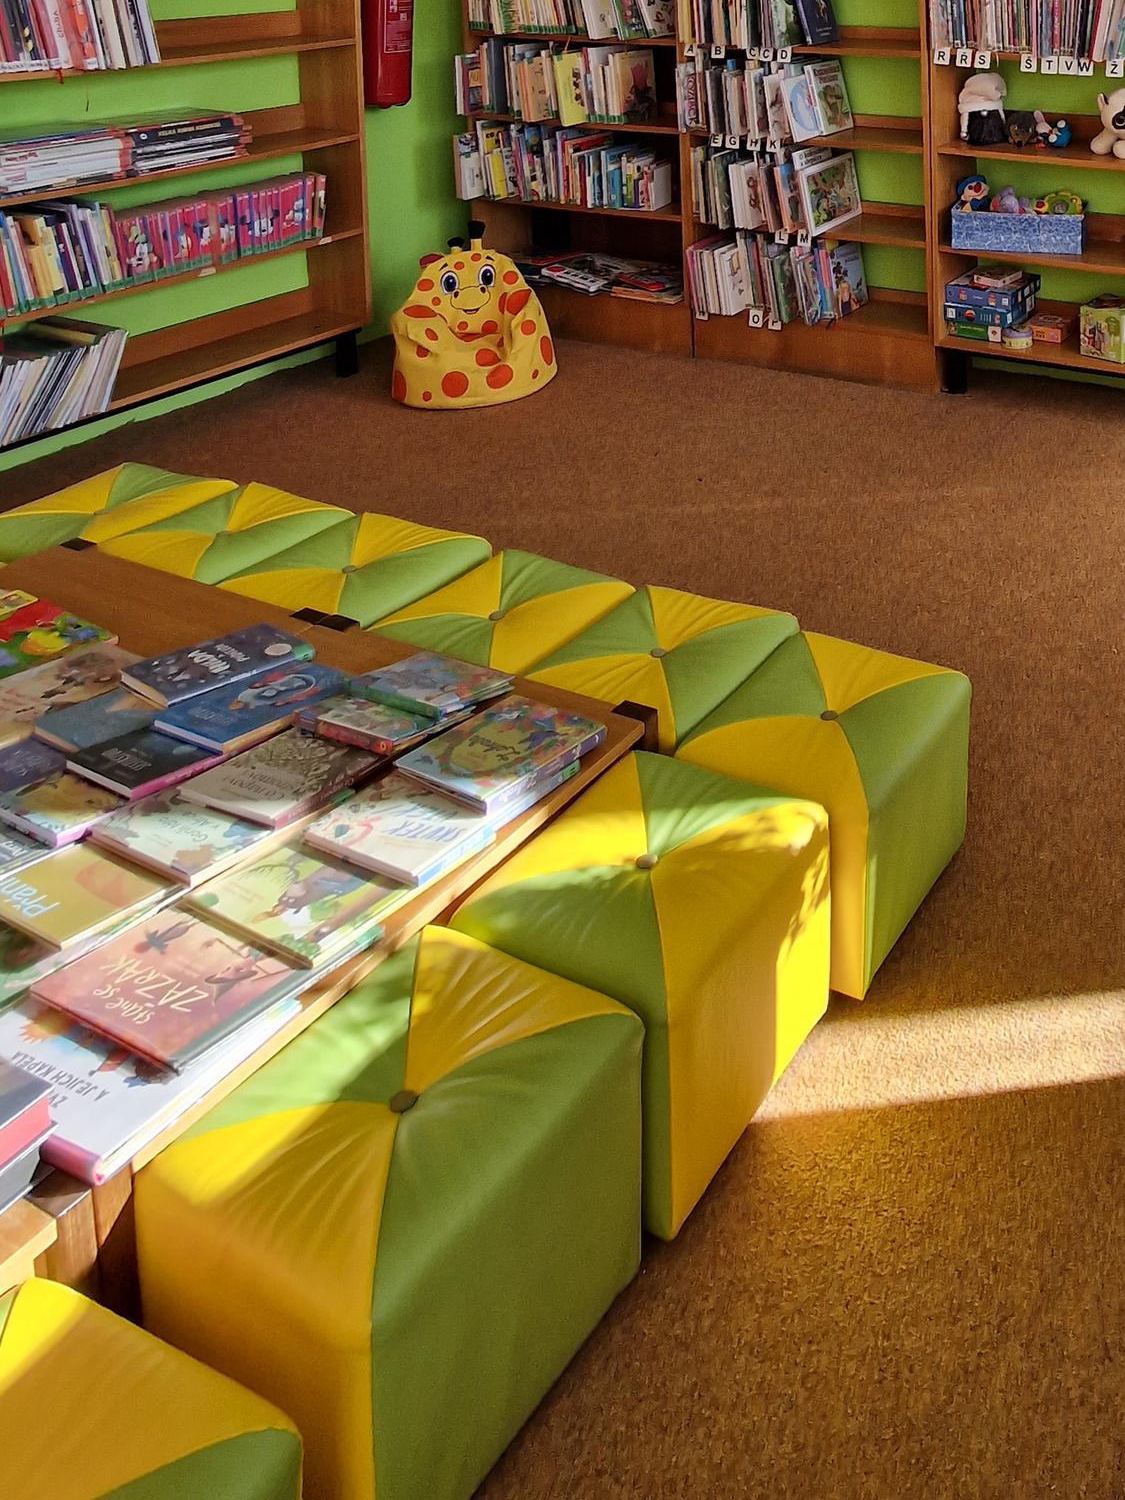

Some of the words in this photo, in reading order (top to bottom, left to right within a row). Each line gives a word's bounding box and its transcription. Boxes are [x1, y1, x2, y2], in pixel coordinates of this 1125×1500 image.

[686, 45, 695, 54] A
[714, 46, 722, 55] B
[780, 50, 788, 60] D
[938, 51, 946, 61] R
[960, 51, 968, 64] Ř
[978, 55, 986, 65] S
[1024, 56, 1032, 69] Š
[1045, 60, 1053, 70] T
[1065, 61, 1073, 71] V
[1078, 62, 1091, 73] W
[1110, 61, 1118, 75] Ž
[712, 135, 719, 144] E
[729, 135, 737, 145] G
[750, 138, 758, 148] H
[769, 139, 777, 149] K
[778, 231, 785, 240] L
[800, 233, 809, 243] M
[752, 314, 759, 324] O
[101, 952, 212, 1014] ZÁZRAK
[9, 1050, 56, 1078] KAPELA
[47, 1069, 98, 1099] JEJICH
